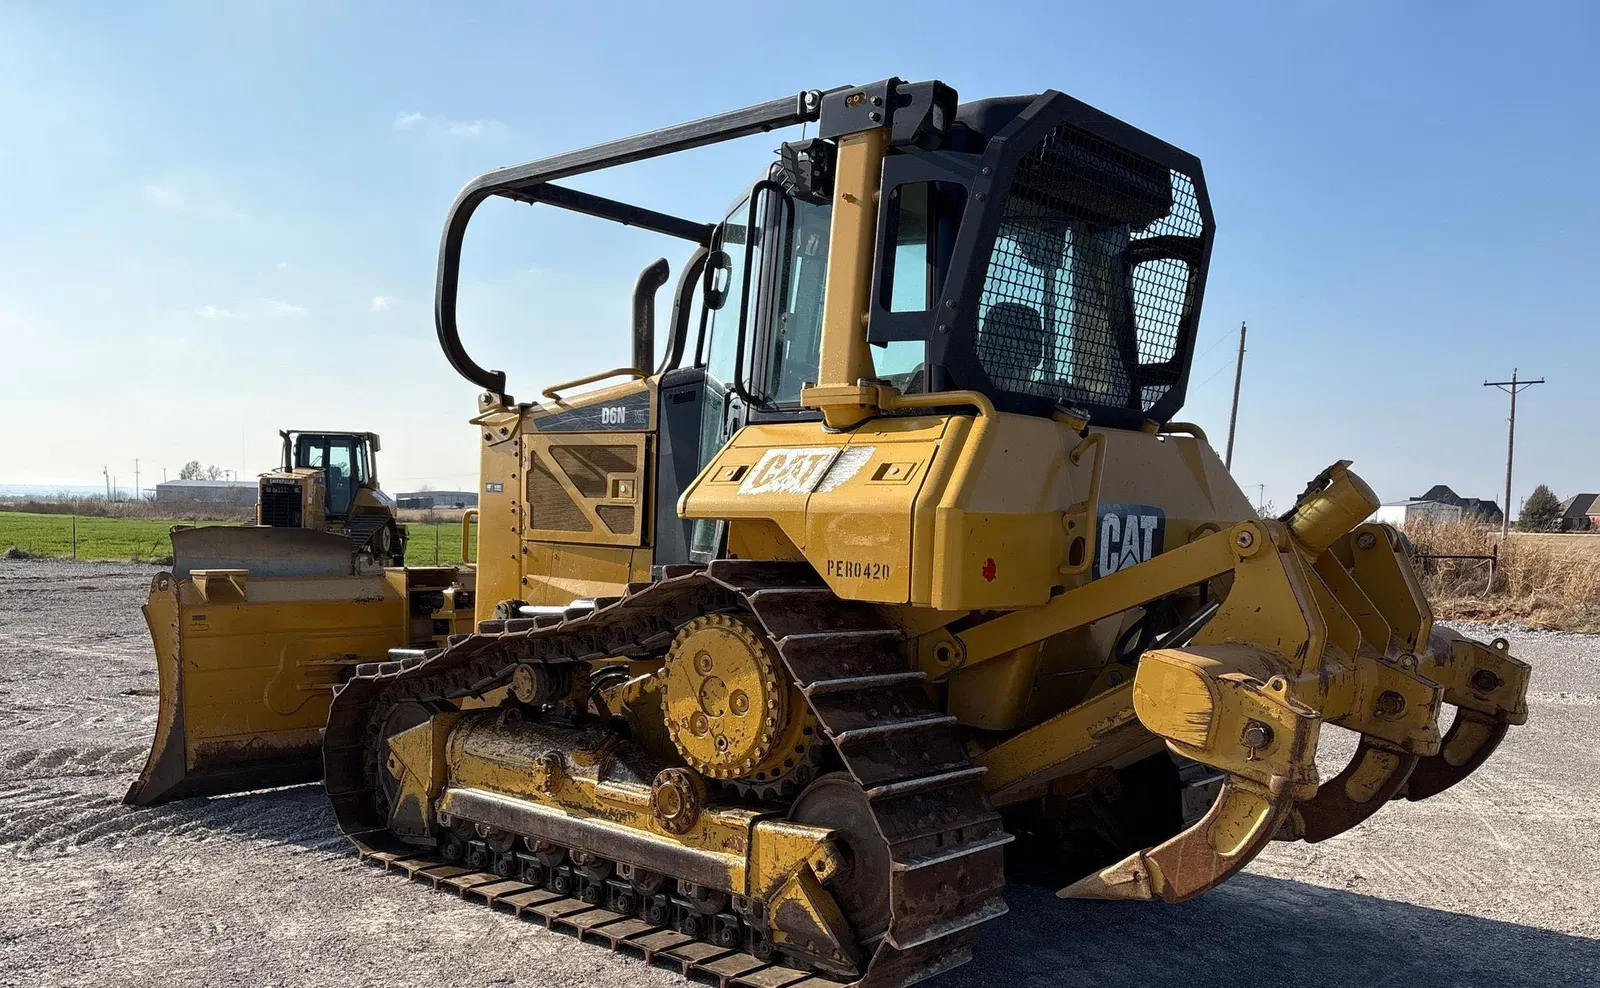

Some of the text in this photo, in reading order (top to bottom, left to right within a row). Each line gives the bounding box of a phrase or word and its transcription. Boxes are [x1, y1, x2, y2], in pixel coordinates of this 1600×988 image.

[602, 407, 625, 424] D6N
[751, 454, 830, 488] CAT
[1099, 512, 1158, 577] CAT
